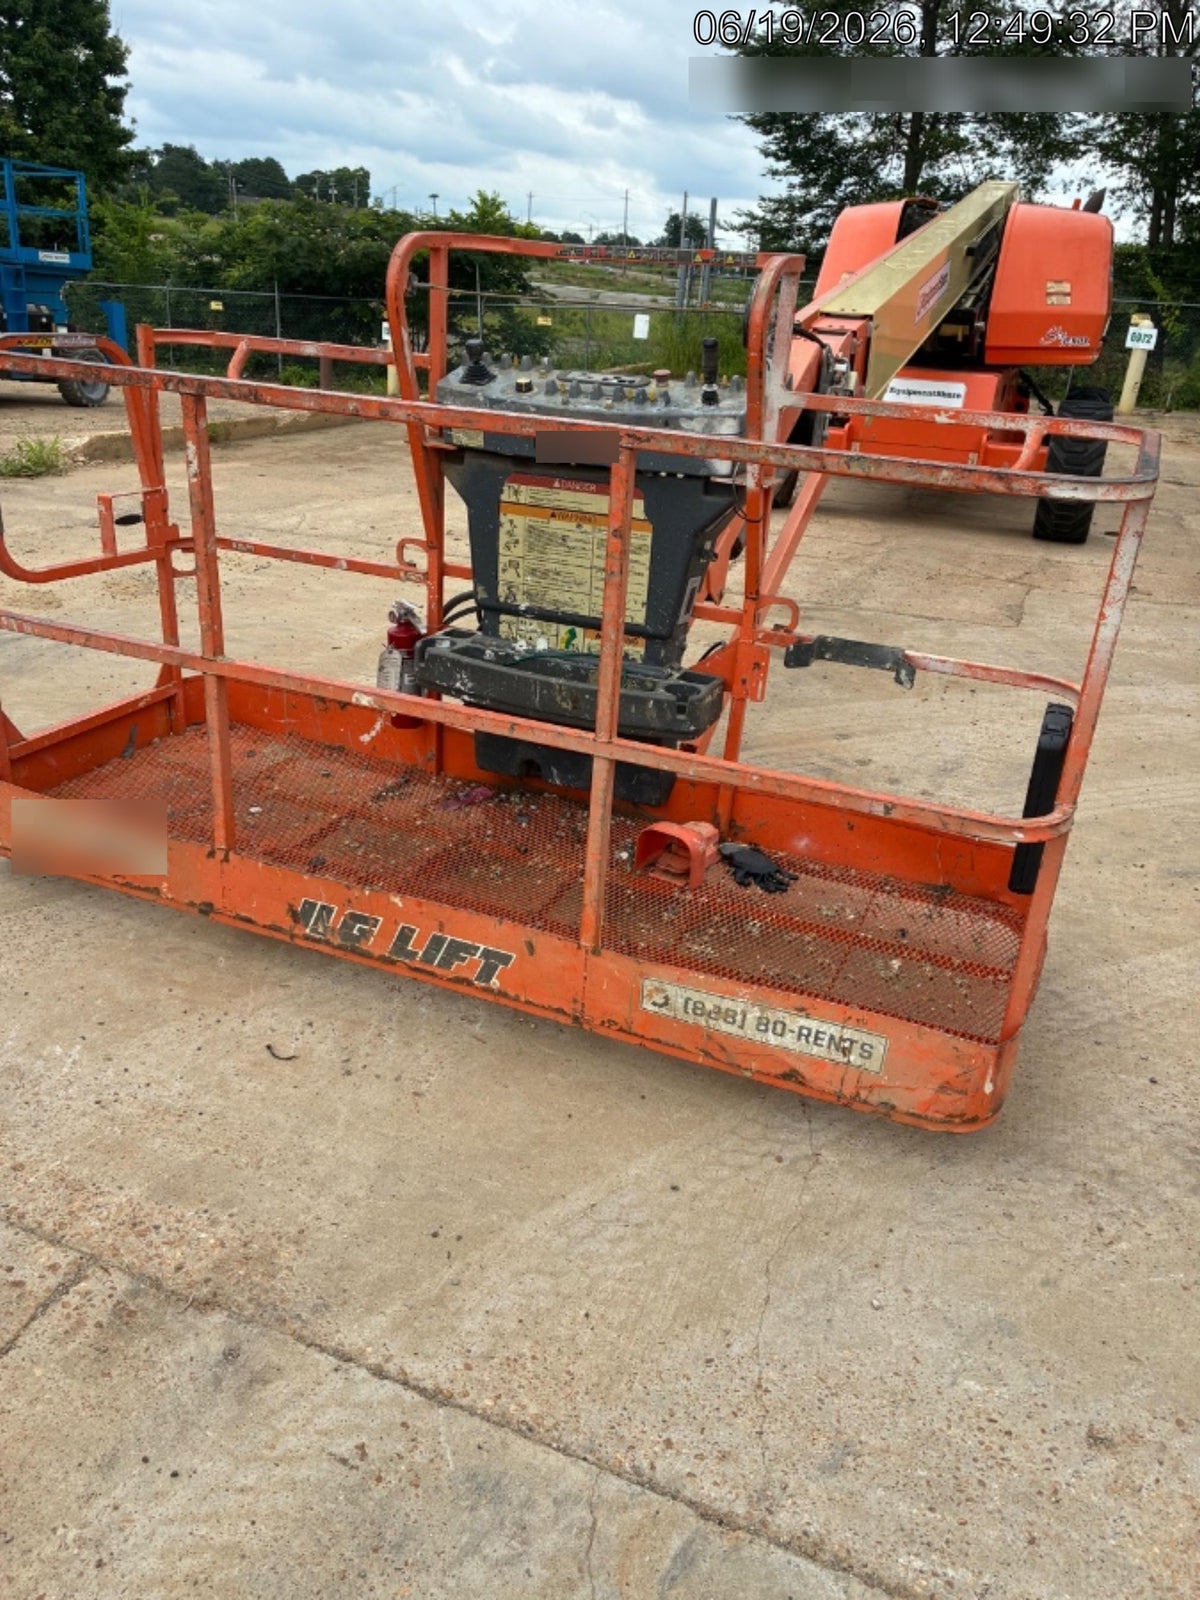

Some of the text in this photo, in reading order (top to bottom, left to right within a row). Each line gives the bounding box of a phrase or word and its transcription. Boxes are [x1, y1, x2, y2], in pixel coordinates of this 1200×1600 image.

[561, 480, 597, 493] DANGER
[388, 922, 516, 986] LIFT
[755, 1016, 875, 1060] 80-RENTS
